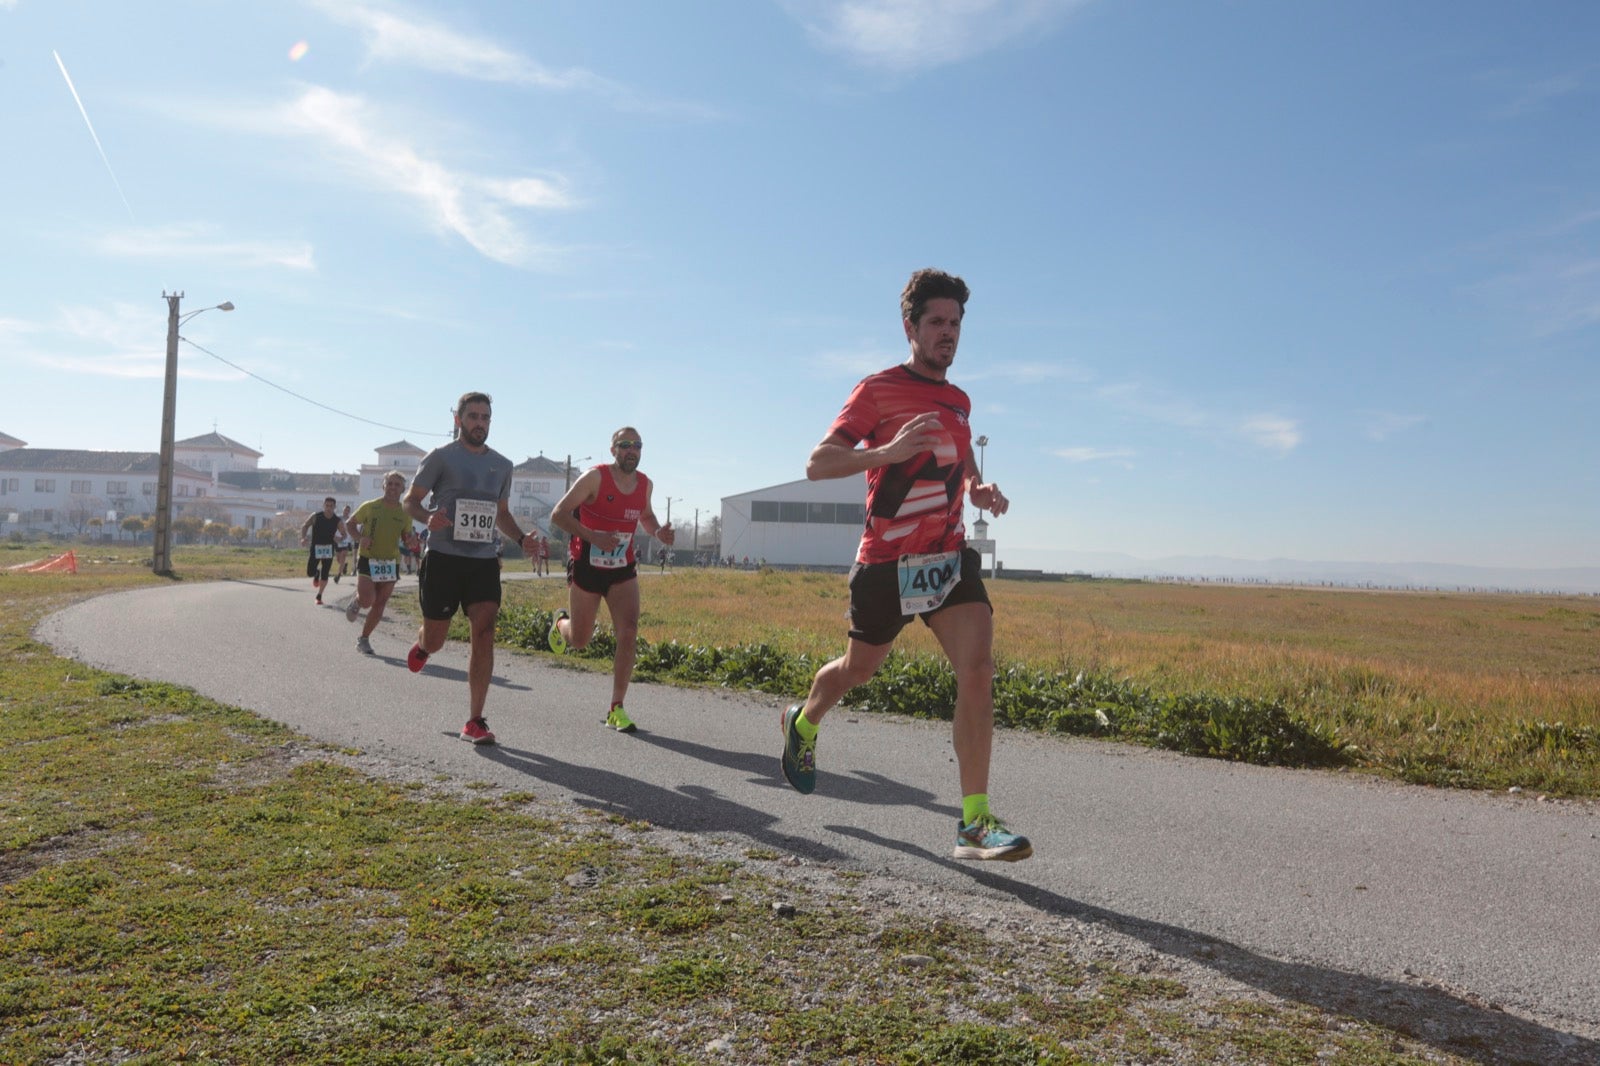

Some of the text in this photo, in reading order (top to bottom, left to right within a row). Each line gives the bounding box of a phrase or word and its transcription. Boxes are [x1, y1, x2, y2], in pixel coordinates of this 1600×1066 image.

[460, 513, 493, 529] 3180
[374, 565, 392, 575] 283
[912, 564, 953, 592] 404
